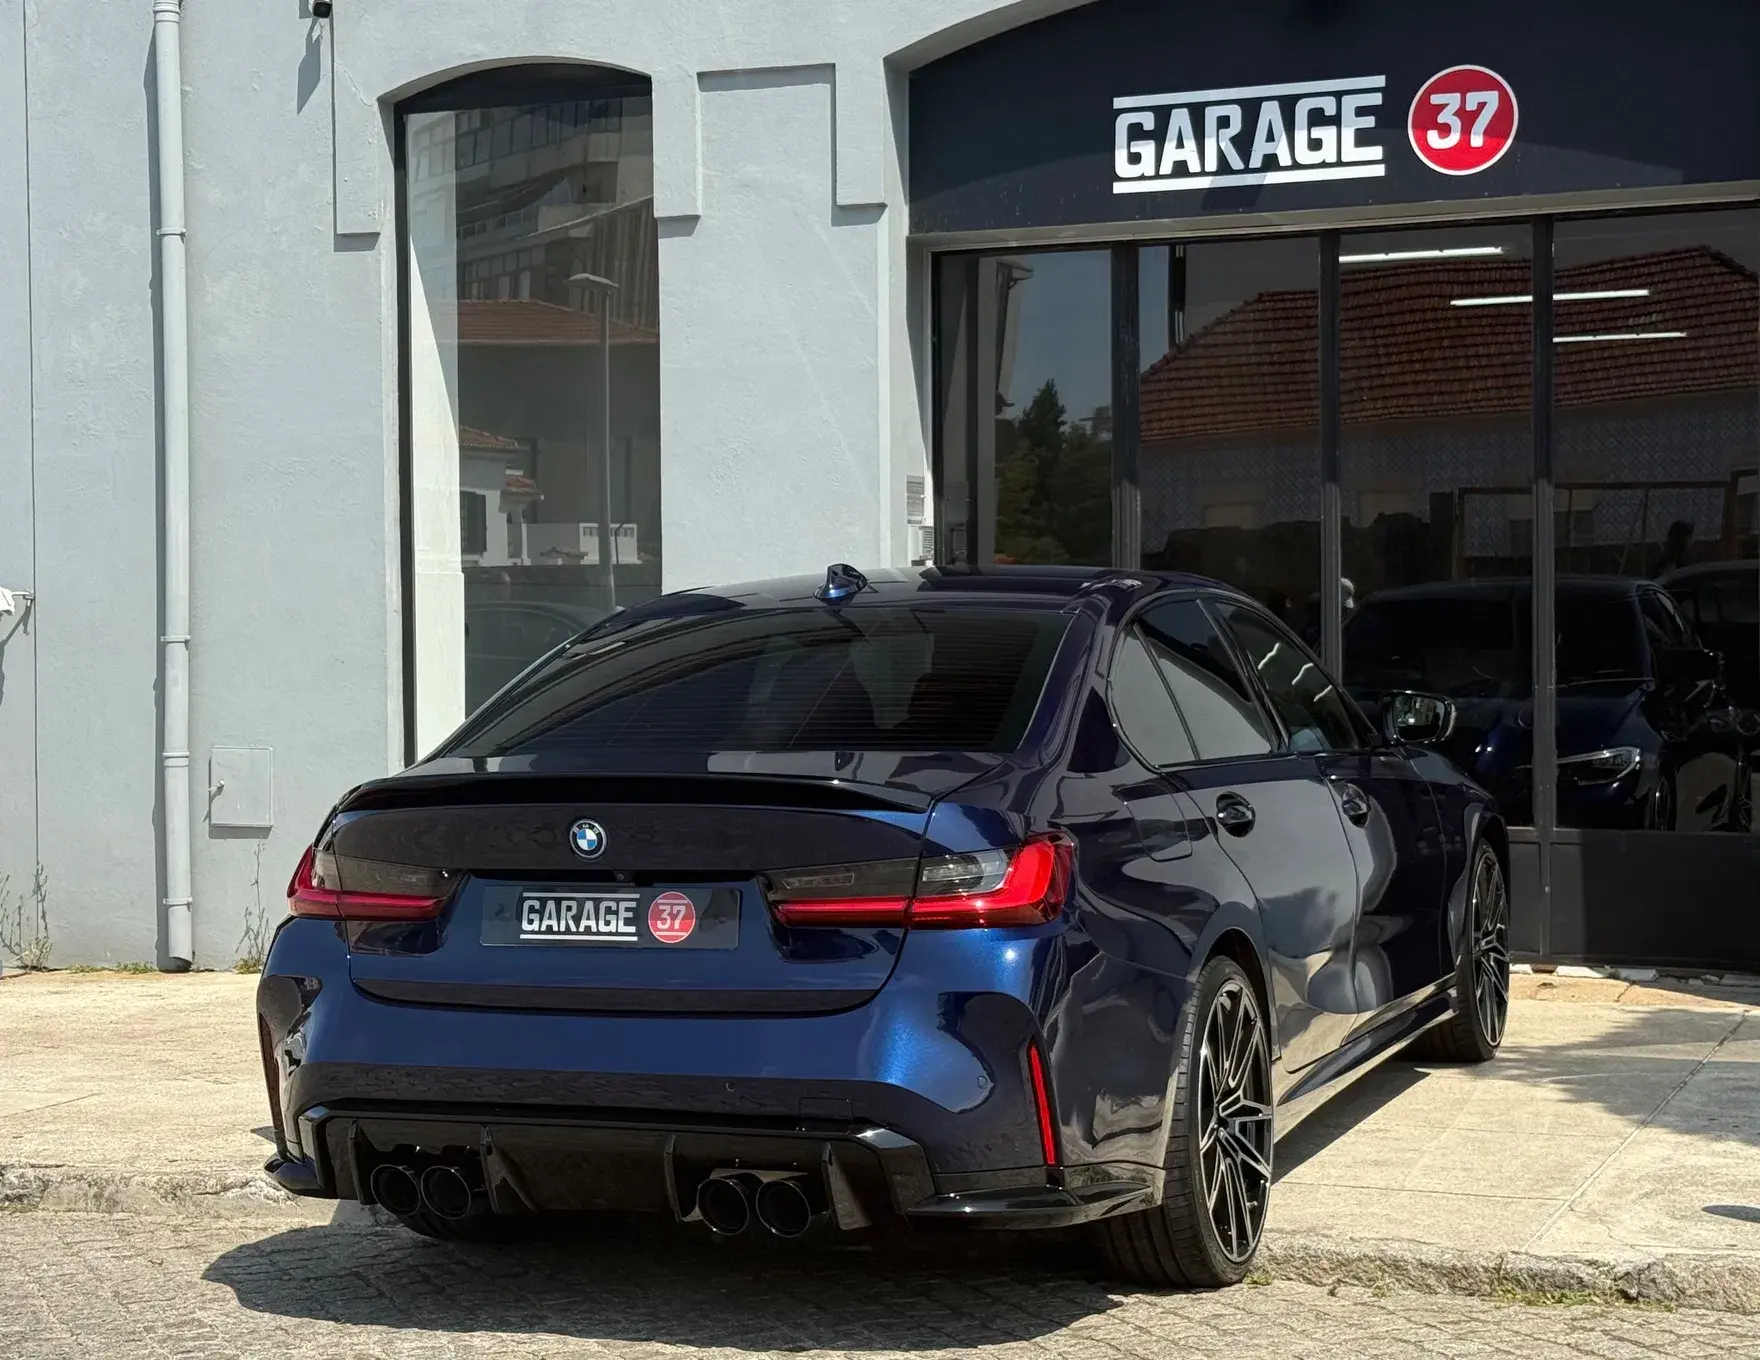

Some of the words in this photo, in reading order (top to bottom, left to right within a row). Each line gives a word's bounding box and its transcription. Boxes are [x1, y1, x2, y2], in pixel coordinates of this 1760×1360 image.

[1114, 92, 1383, 178] GARAGE
[1426, 90, 1499, 149] 37
[521, 899, 637, 933] GARAGE
[656, 905, 686, 930] 37
